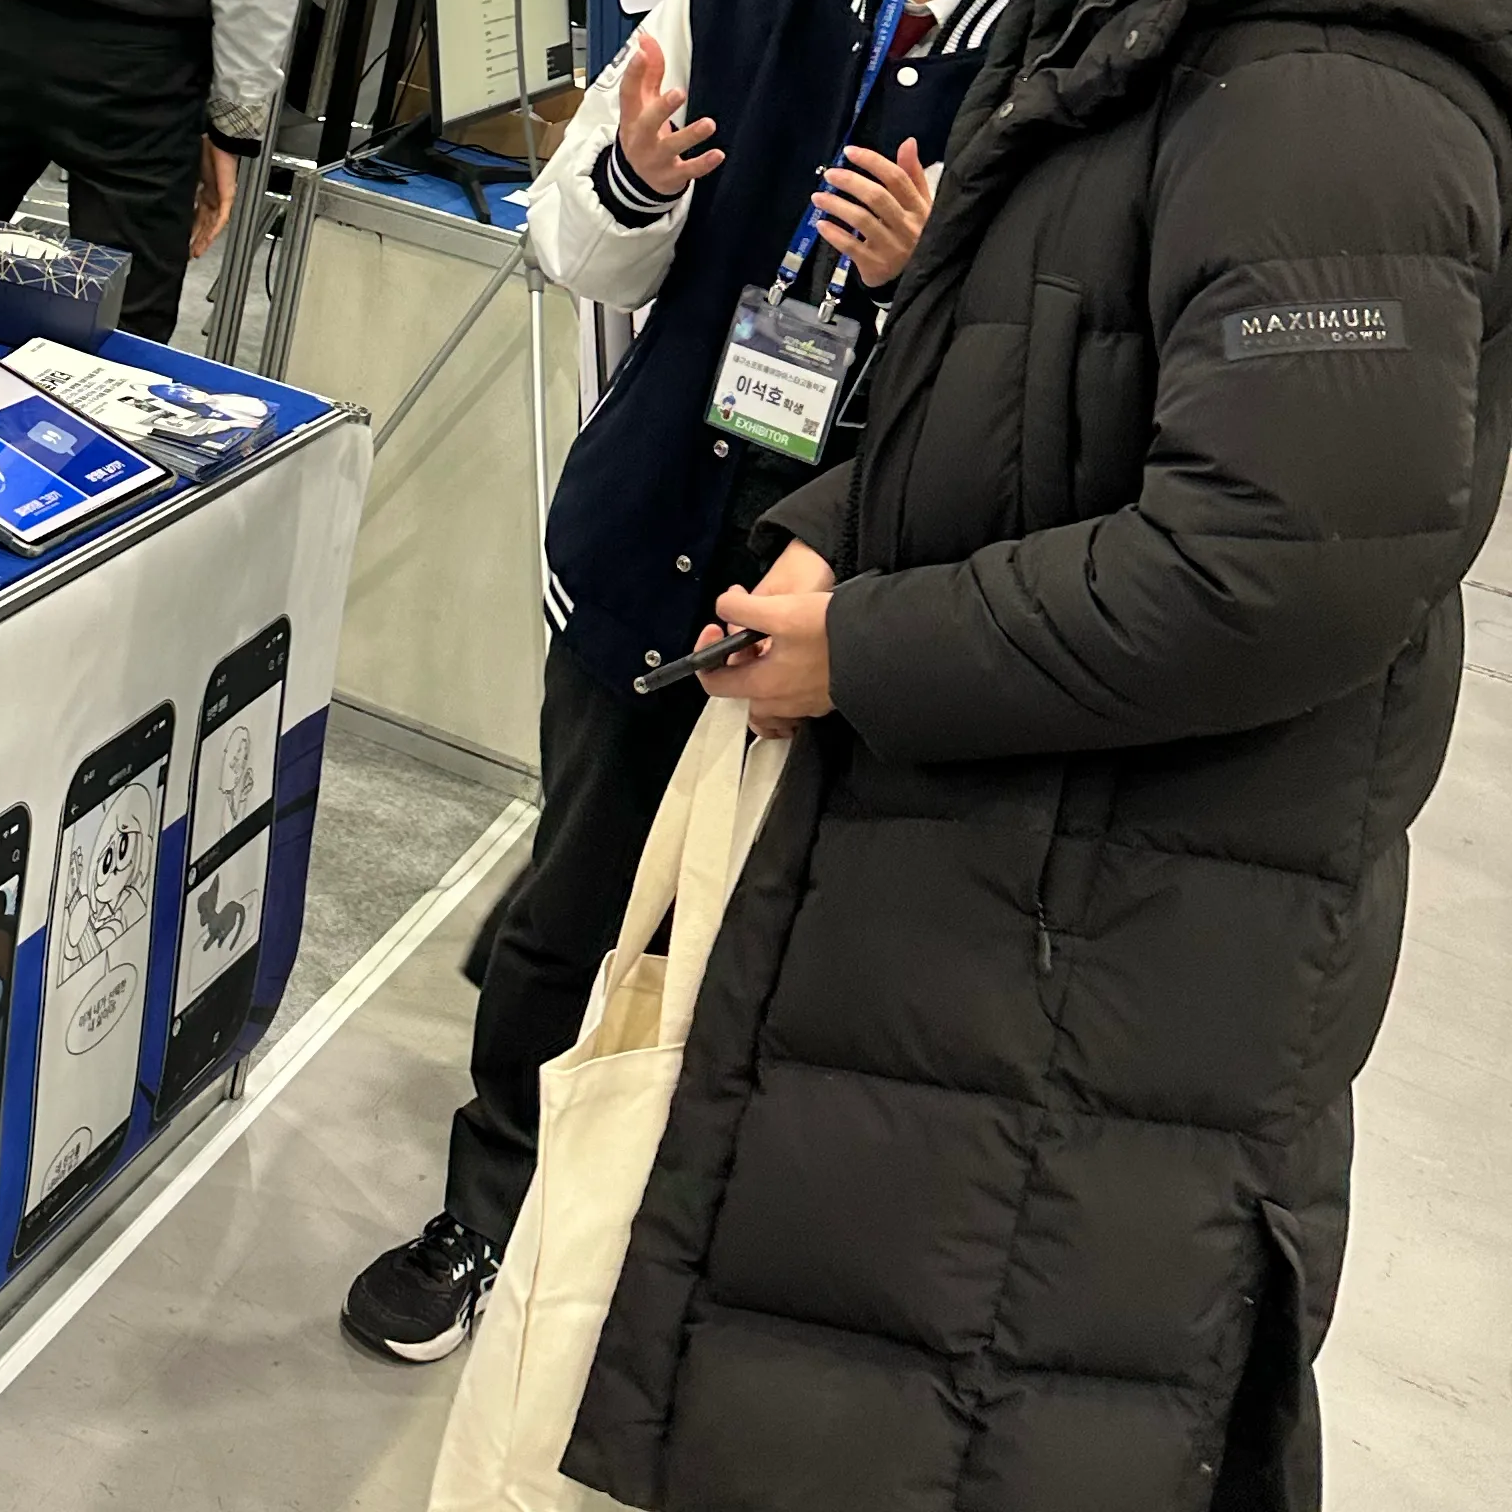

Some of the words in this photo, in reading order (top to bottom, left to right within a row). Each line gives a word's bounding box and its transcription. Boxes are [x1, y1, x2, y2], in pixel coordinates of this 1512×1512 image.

[1240, 307, 1386, 337] MAXIMUM
[736, 374, 783, 407] 이석호
[734, 417, 790, 446] EXHIBITOR
